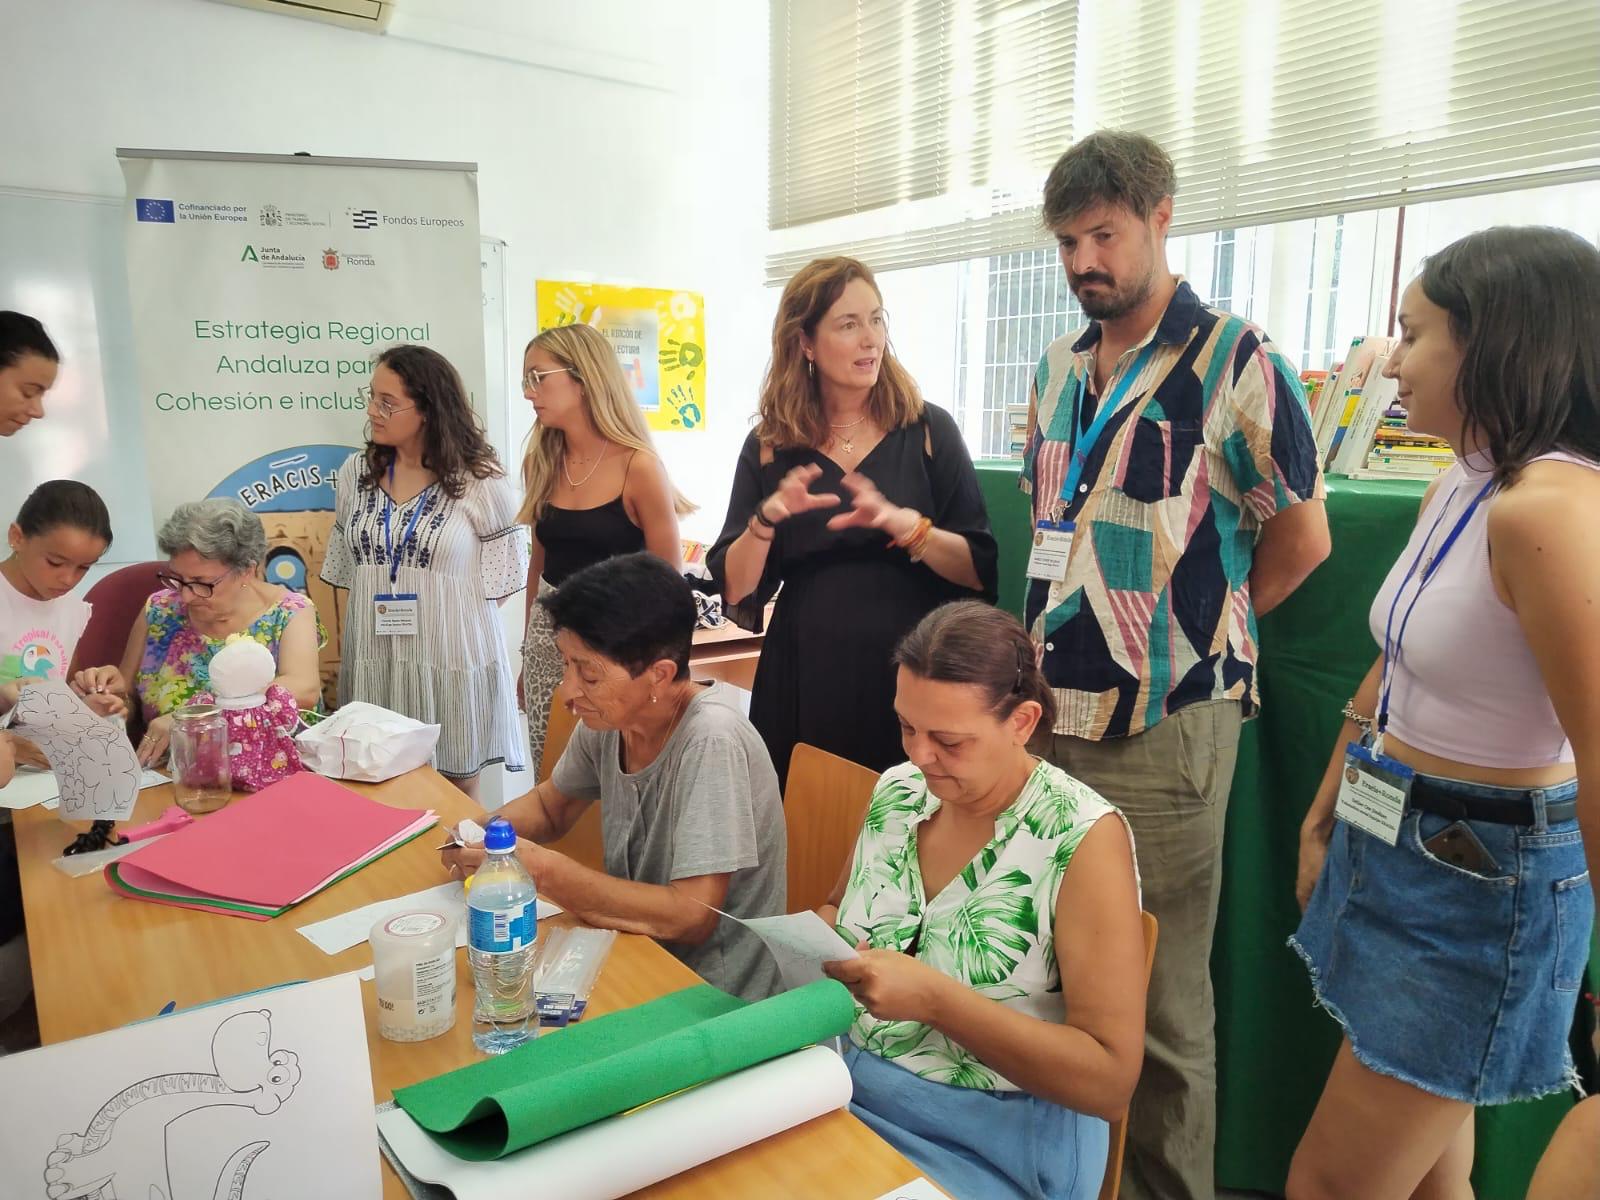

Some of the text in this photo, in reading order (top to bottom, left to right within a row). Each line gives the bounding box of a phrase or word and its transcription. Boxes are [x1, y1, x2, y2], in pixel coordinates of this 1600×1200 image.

[178, 203, 231, 212] Cofinanciado
[214, 213, 248, 222] Europea
[382, 215, 465, 228] Fondos Europeos
[346, 256, 376, 266] Ronda
[195, 319, 430, 345] Estrategia Regional
[216, 354, 376, 379] Andaluza par
[155, 391, 366, 411] Cohesión e inclus
